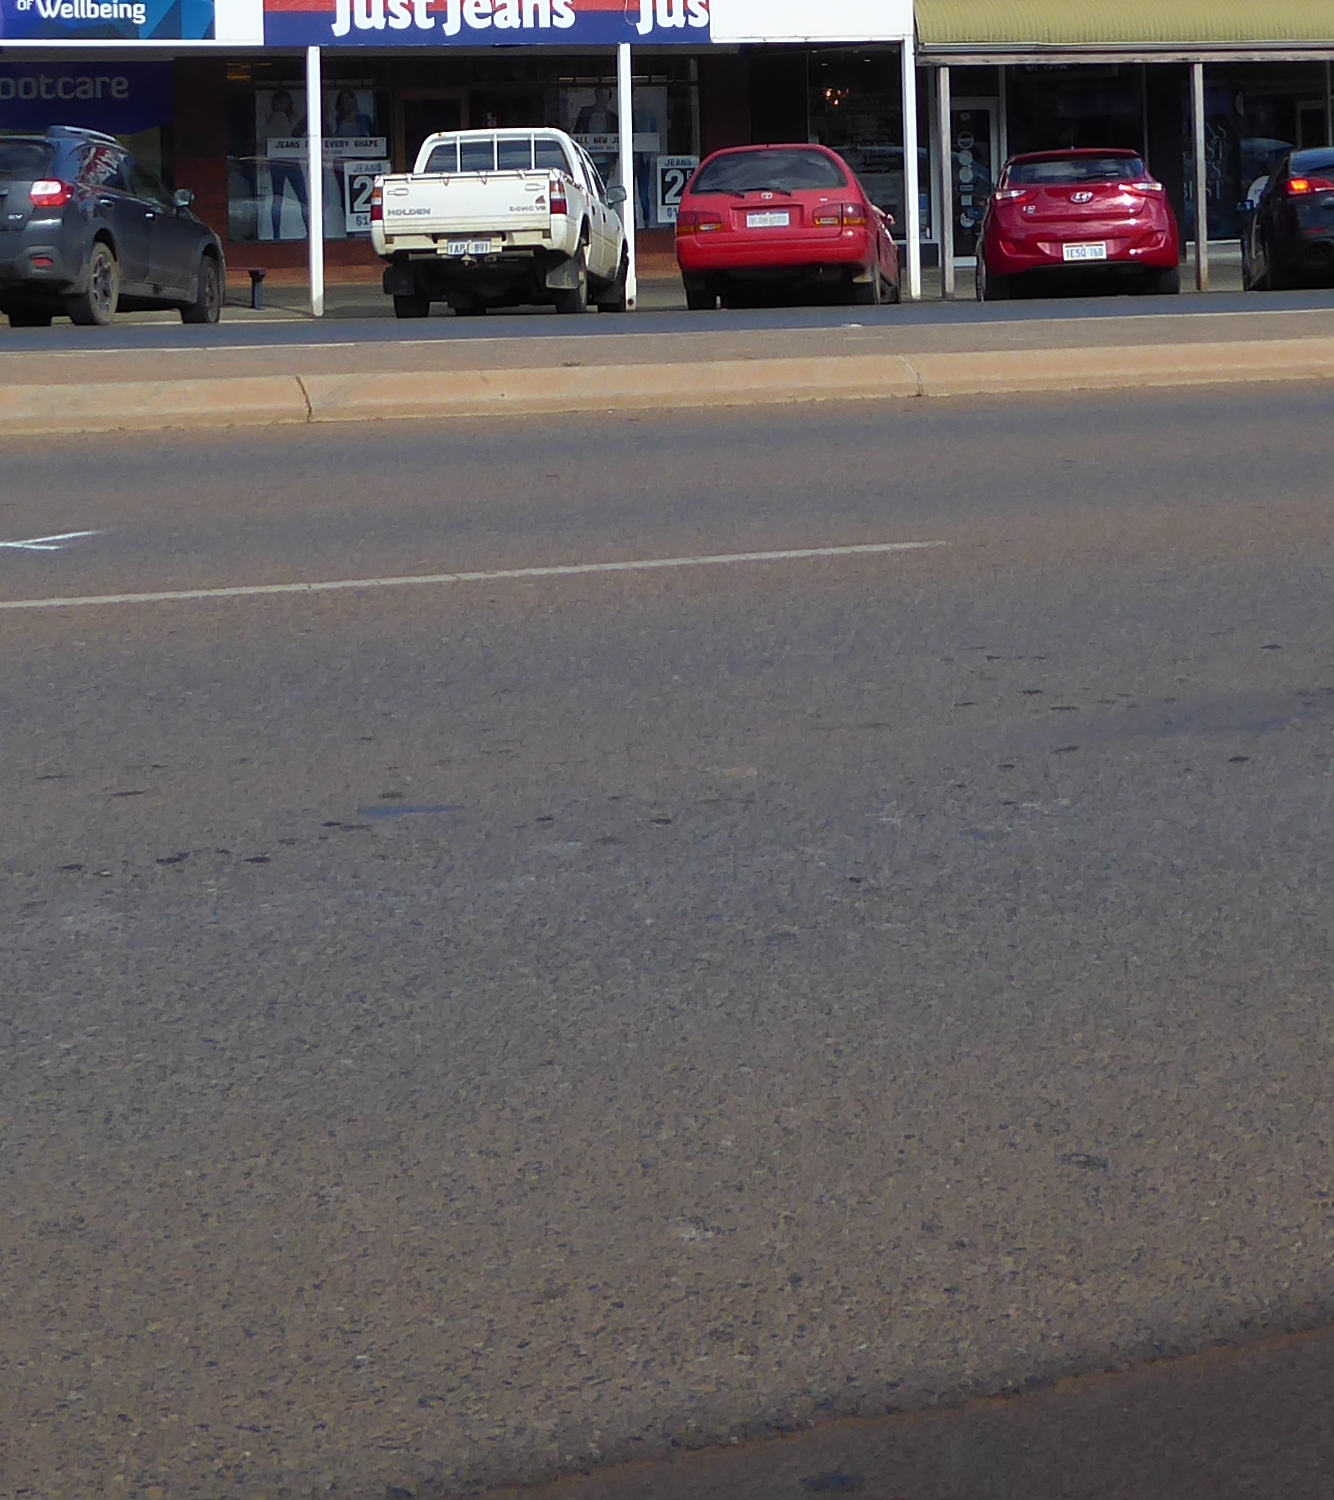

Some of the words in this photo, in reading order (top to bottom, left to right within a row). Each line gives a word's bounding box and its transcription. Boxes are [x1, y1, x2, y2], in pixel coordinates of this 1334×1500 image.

[664, 158, 692, 167] JEANS
[352, 163, 382, 173] JEANS
[387, 208, 432, 216] HOLDEN
